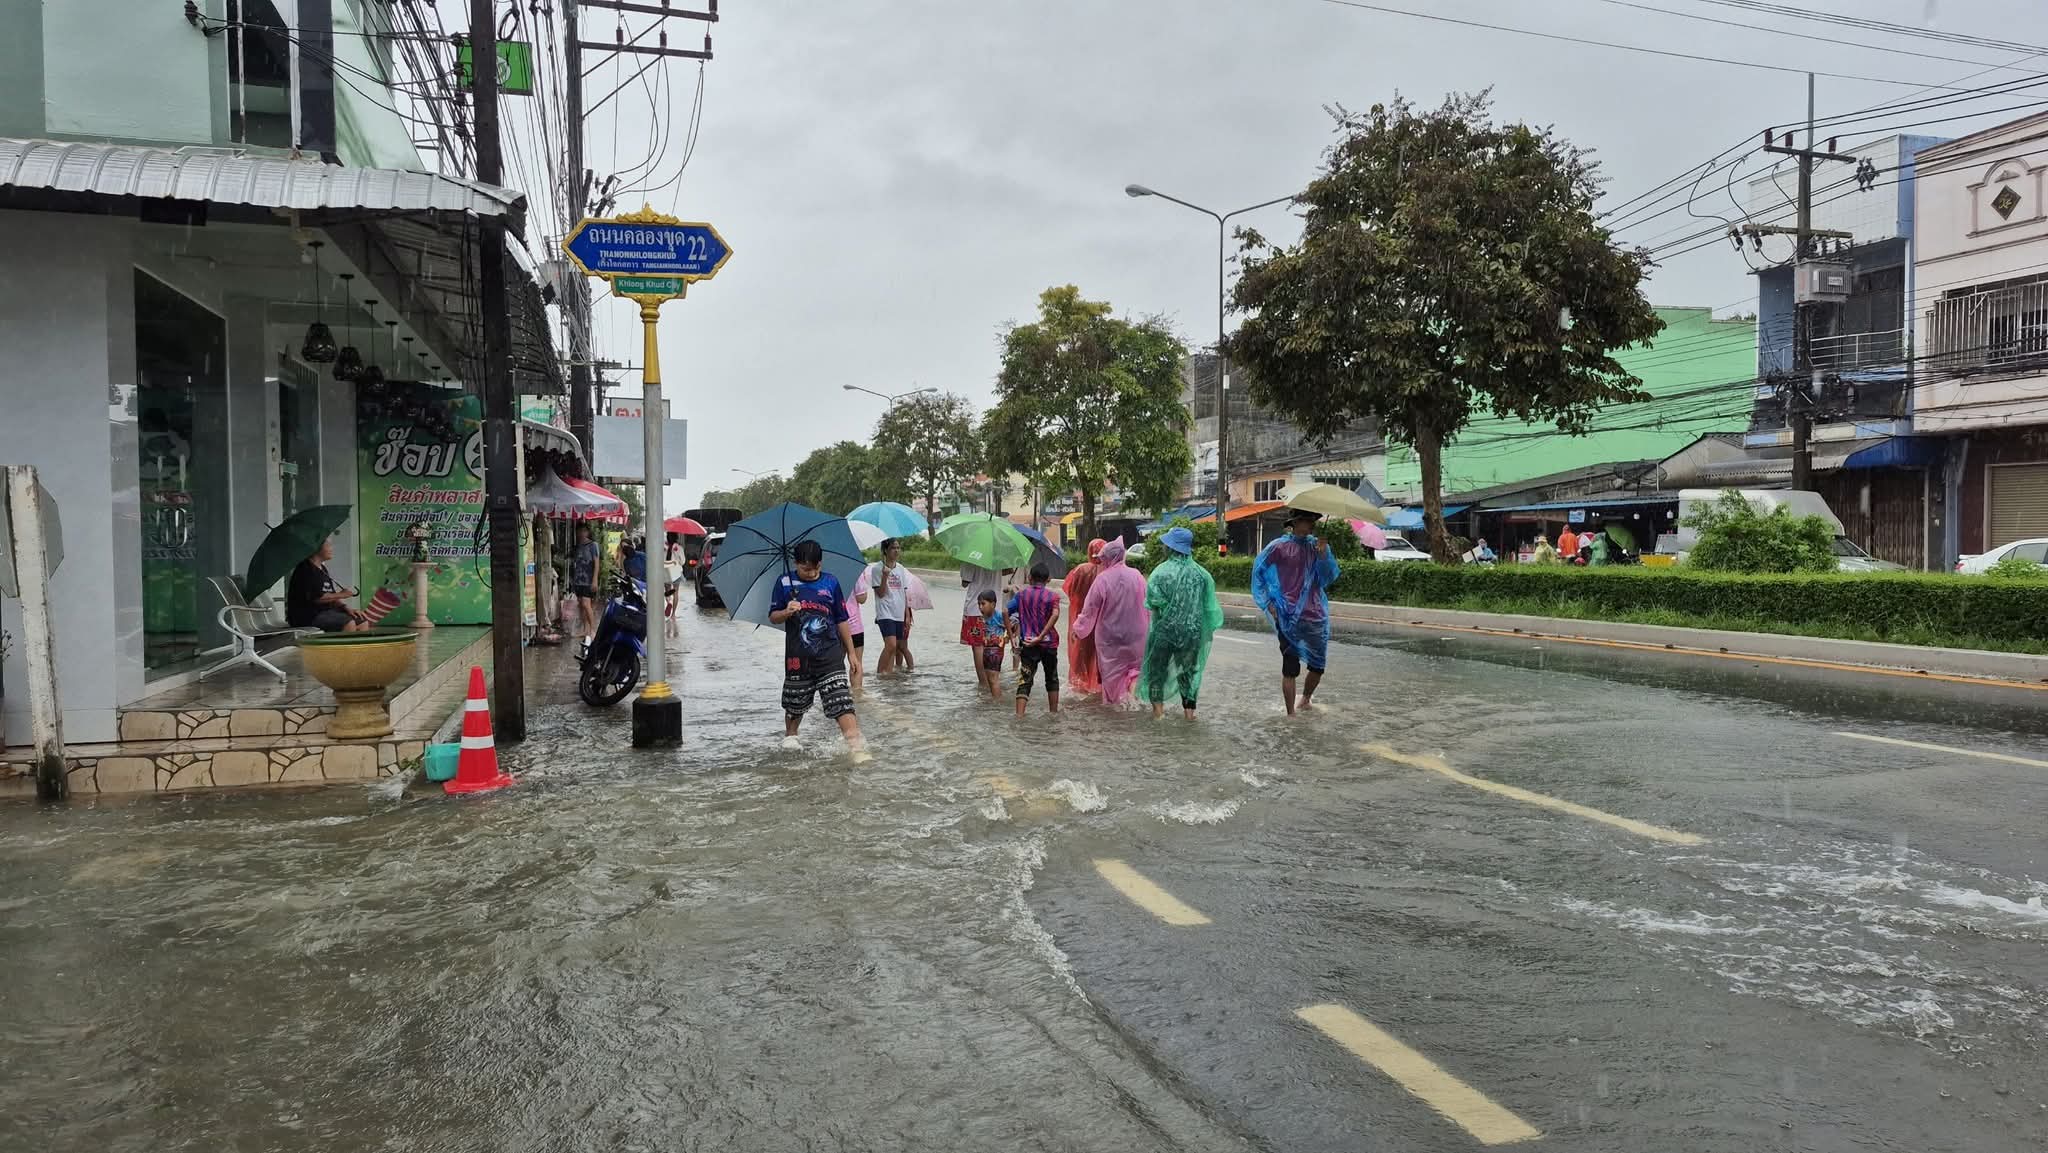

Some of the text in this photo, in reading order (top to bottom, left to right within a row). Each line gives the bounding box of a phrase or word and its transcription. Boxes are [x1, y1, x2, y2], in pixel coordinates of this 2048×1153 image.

[589, 228, 707, 260] ถนนคลองขุด 22
[646, 280, 665, 288] Khud
[389, 483, 483, 504] สินค้าพลาส
